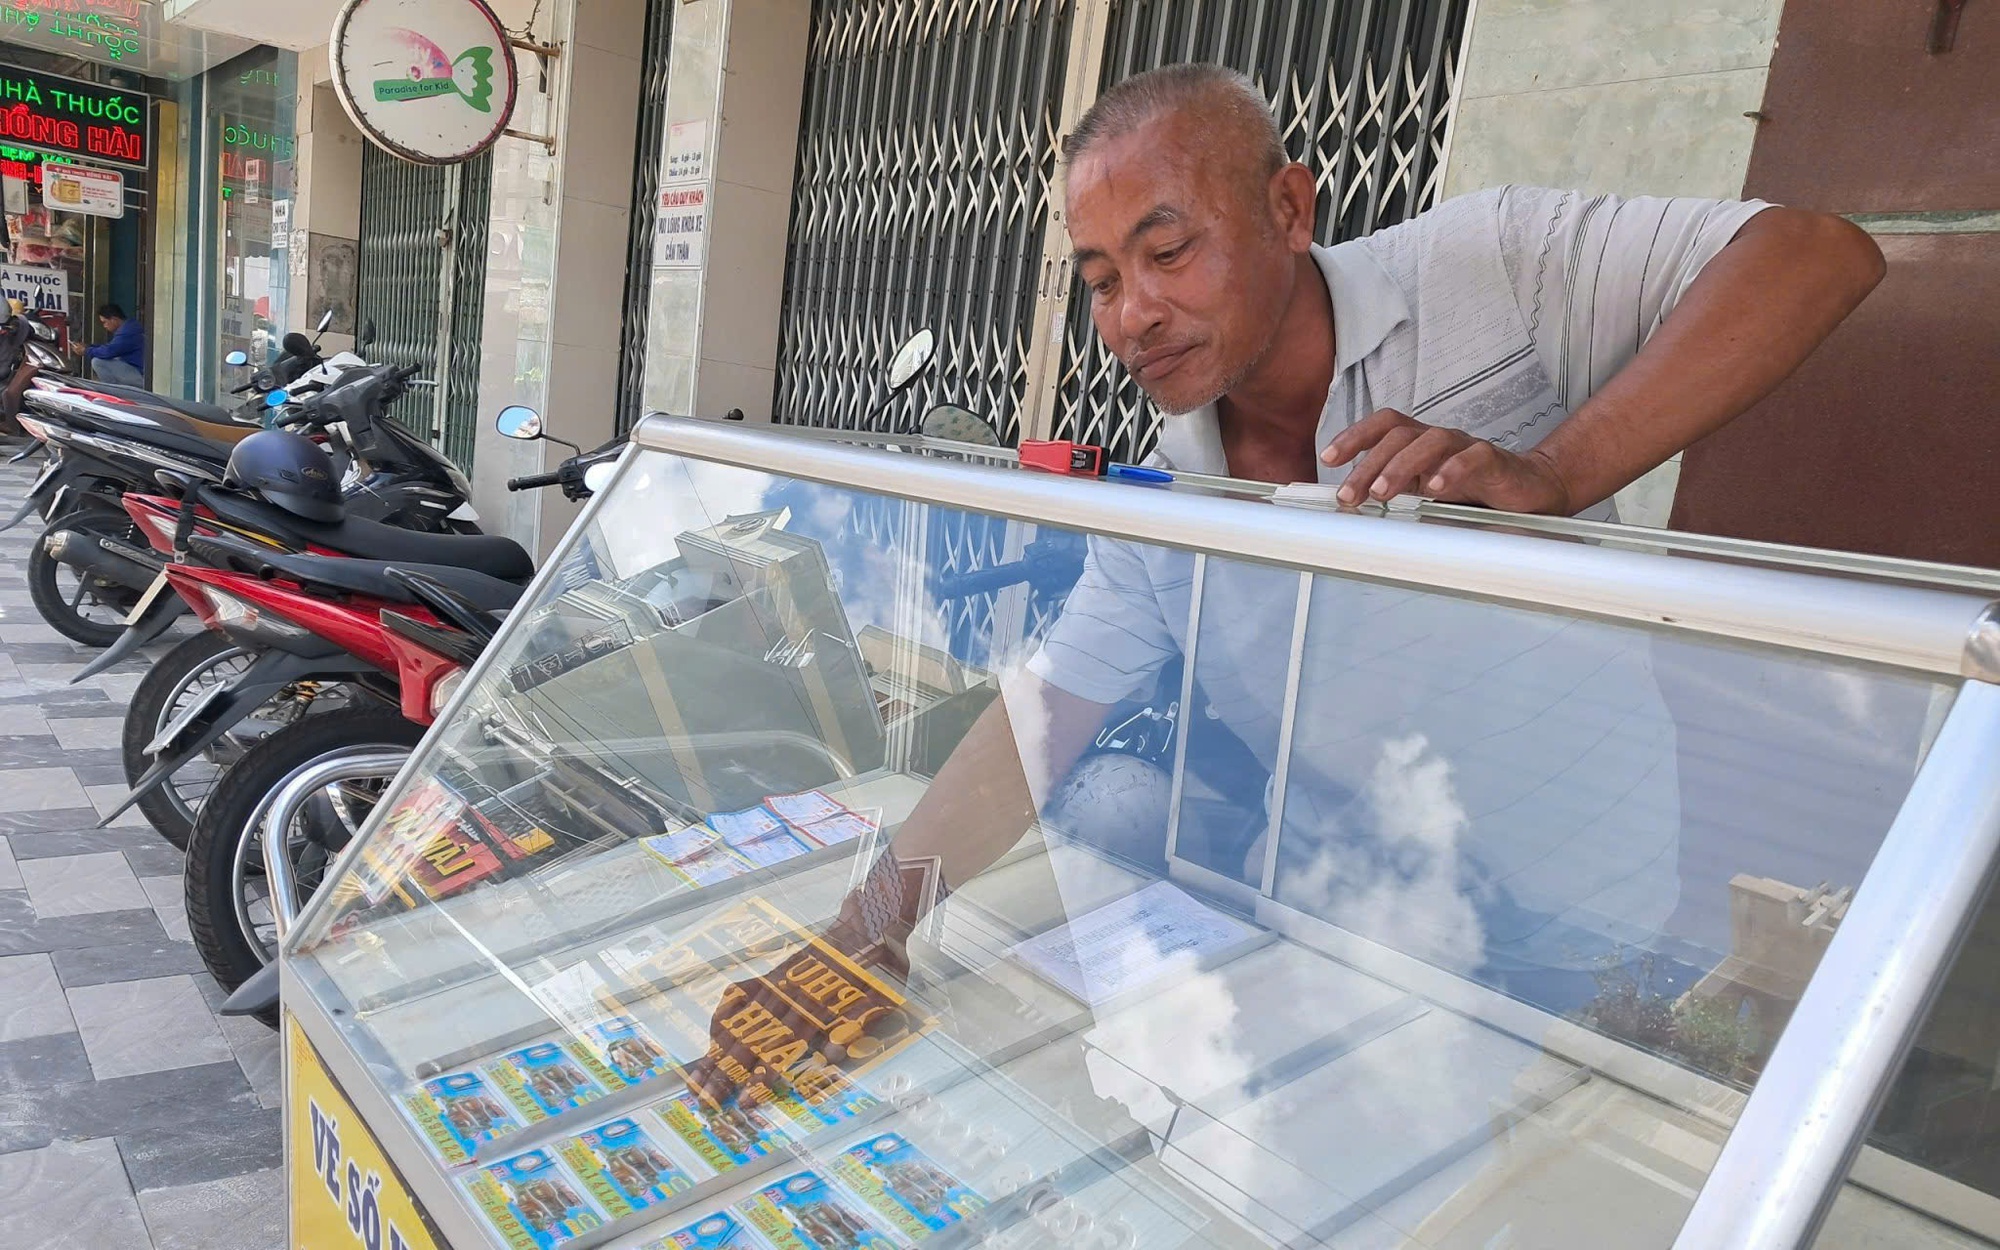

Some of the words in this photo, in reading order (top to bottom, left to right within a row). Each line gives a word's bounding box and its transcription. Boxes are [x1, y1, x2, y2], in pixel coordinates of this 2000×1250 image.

[0, 78, 42, 105] HÀ
[50, 90, 139, 124] THUỐC
[379, 86, 418, 95] Paradise
[311, 1099, 341, 1204] VÉ
[348, 1161, 381, 1250] SỐ
